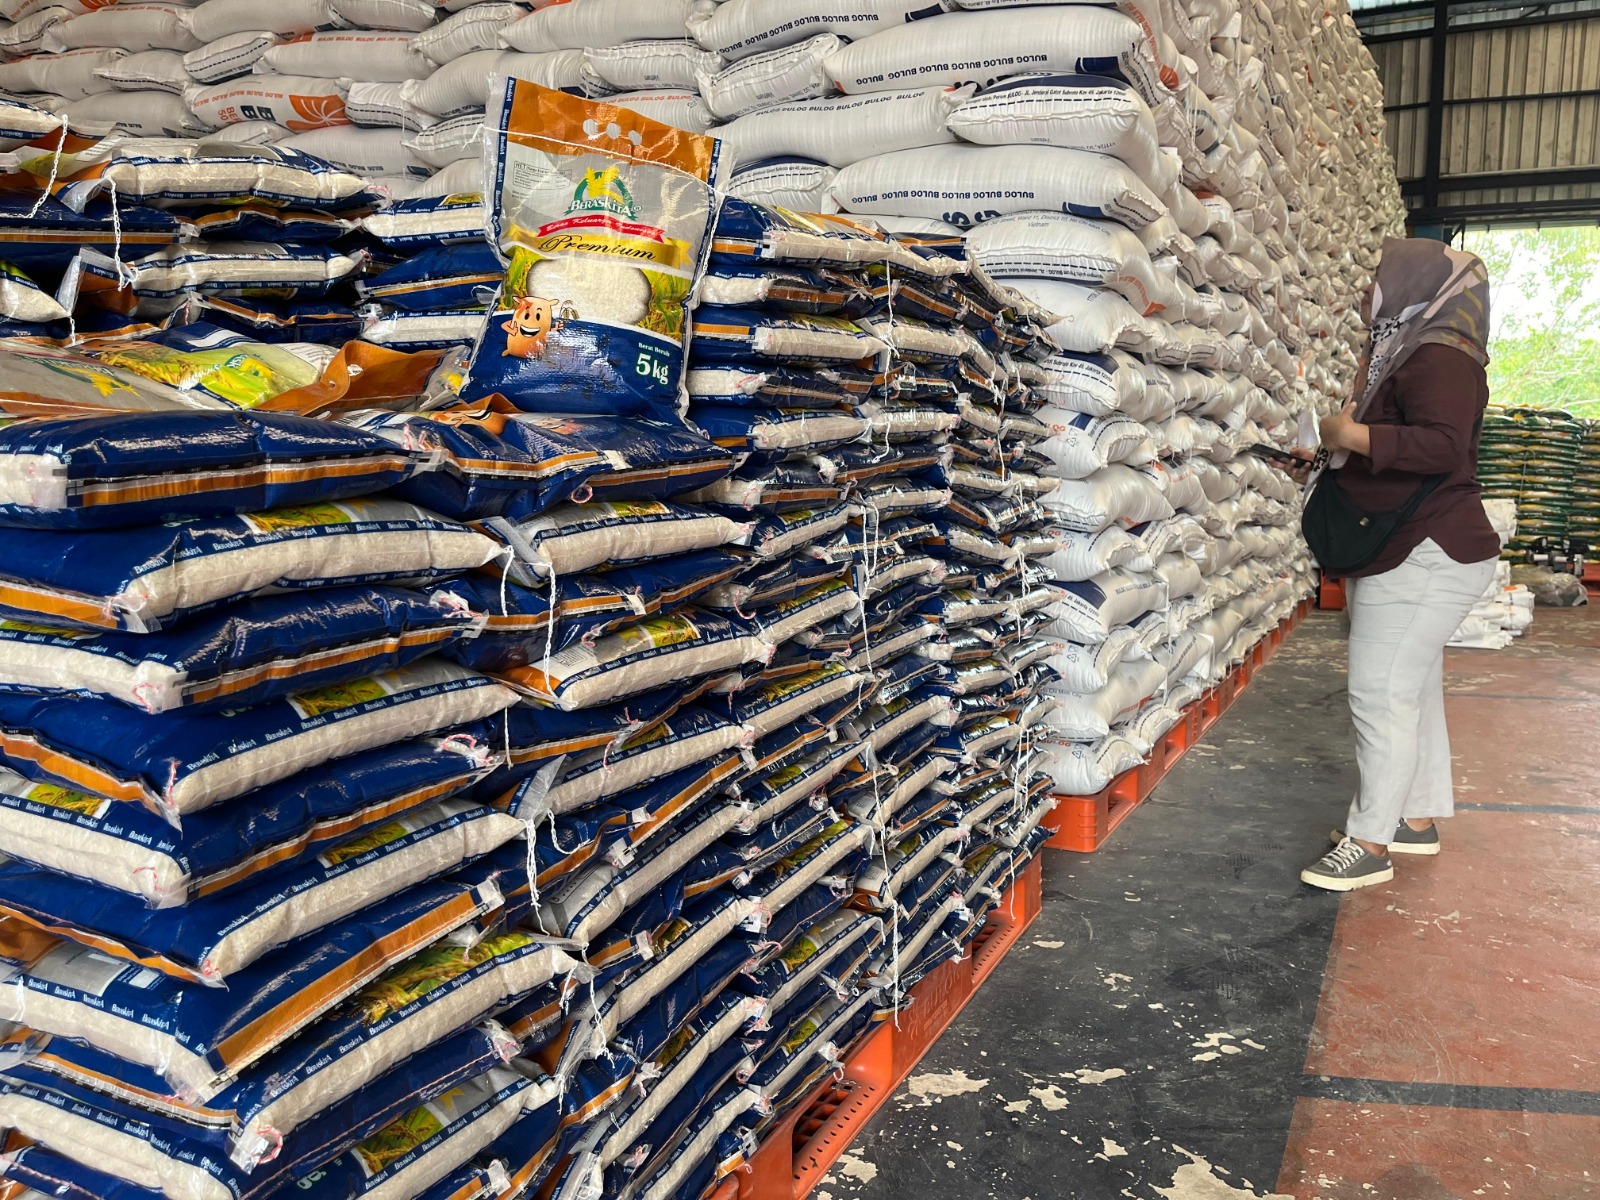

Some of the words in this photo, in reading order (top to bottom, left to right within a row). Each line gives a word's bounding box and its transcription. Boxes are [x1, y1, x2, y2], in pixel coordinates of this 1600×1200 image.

[795, 15, 820, 27] BULOG
[852, 14, 879, 22] BULOG
[770, 22, 793, 37] BULOG
[745, 31, 768, 46] BULOG
[718, 42, 743, 54] BULOG
[984, 58, 1013, 66] BULOG
[1017, 55, 1047, 63] BULOG
[920, 64, 949, 74] BULOG
[952, 61, 981, 70] BULOG
[888, 69, 917, 79] BULOG
[856, 74, 884, 85] BULOG
[836, 101, 863, 110] BULOG
[865, 95, 892, 105] BULOG
[897, 91, 925, 100] BULOG
[852, 195, 877, 203] BULOG
[882, 191, 908, 199] BULOG
[911, 190, 939, 198] BULOG
[973, 191, 1002, 199] BULOG
[1005, 191, 1034, 199] BULOG
[540, 235, 656, 260] Premium
[639, 342, 653, 351] Berat
[636, 353, 651, 375] 5
[652, 360, 668, 384] kg
[1085, 365, 1101, 375] Jakarta
